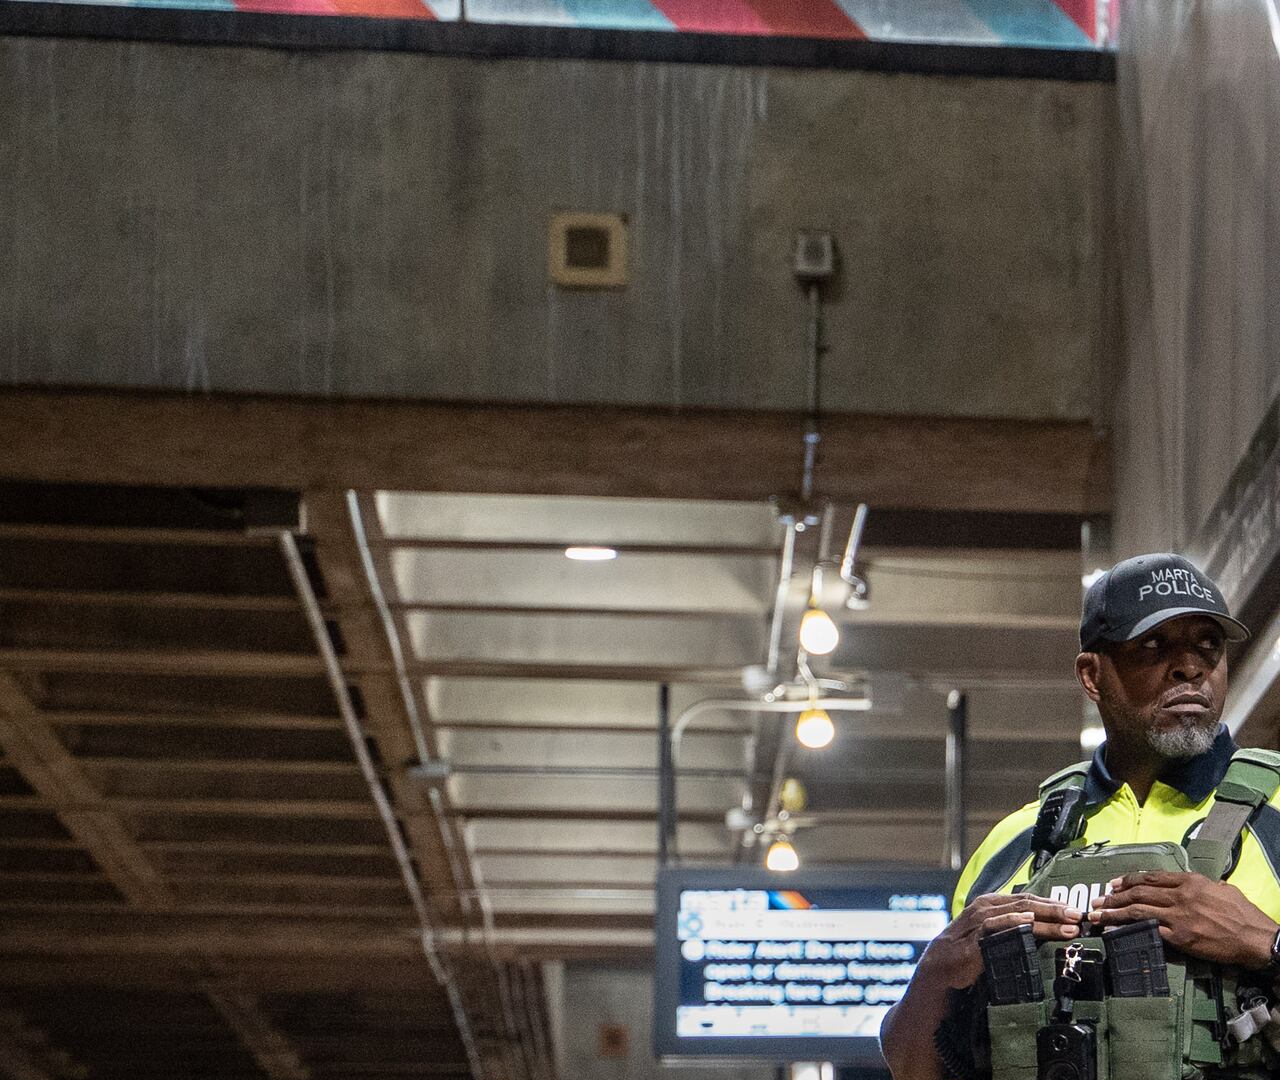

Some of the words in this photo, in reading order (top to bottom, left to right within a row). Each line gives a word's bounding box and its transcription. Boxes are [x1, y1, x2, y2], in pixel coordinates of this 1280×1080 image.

[1151, 568, 1199, 584] MARTA
[1138, 580, 1216, 604] POLICE
[1049, 882, 1113, 914] POL
